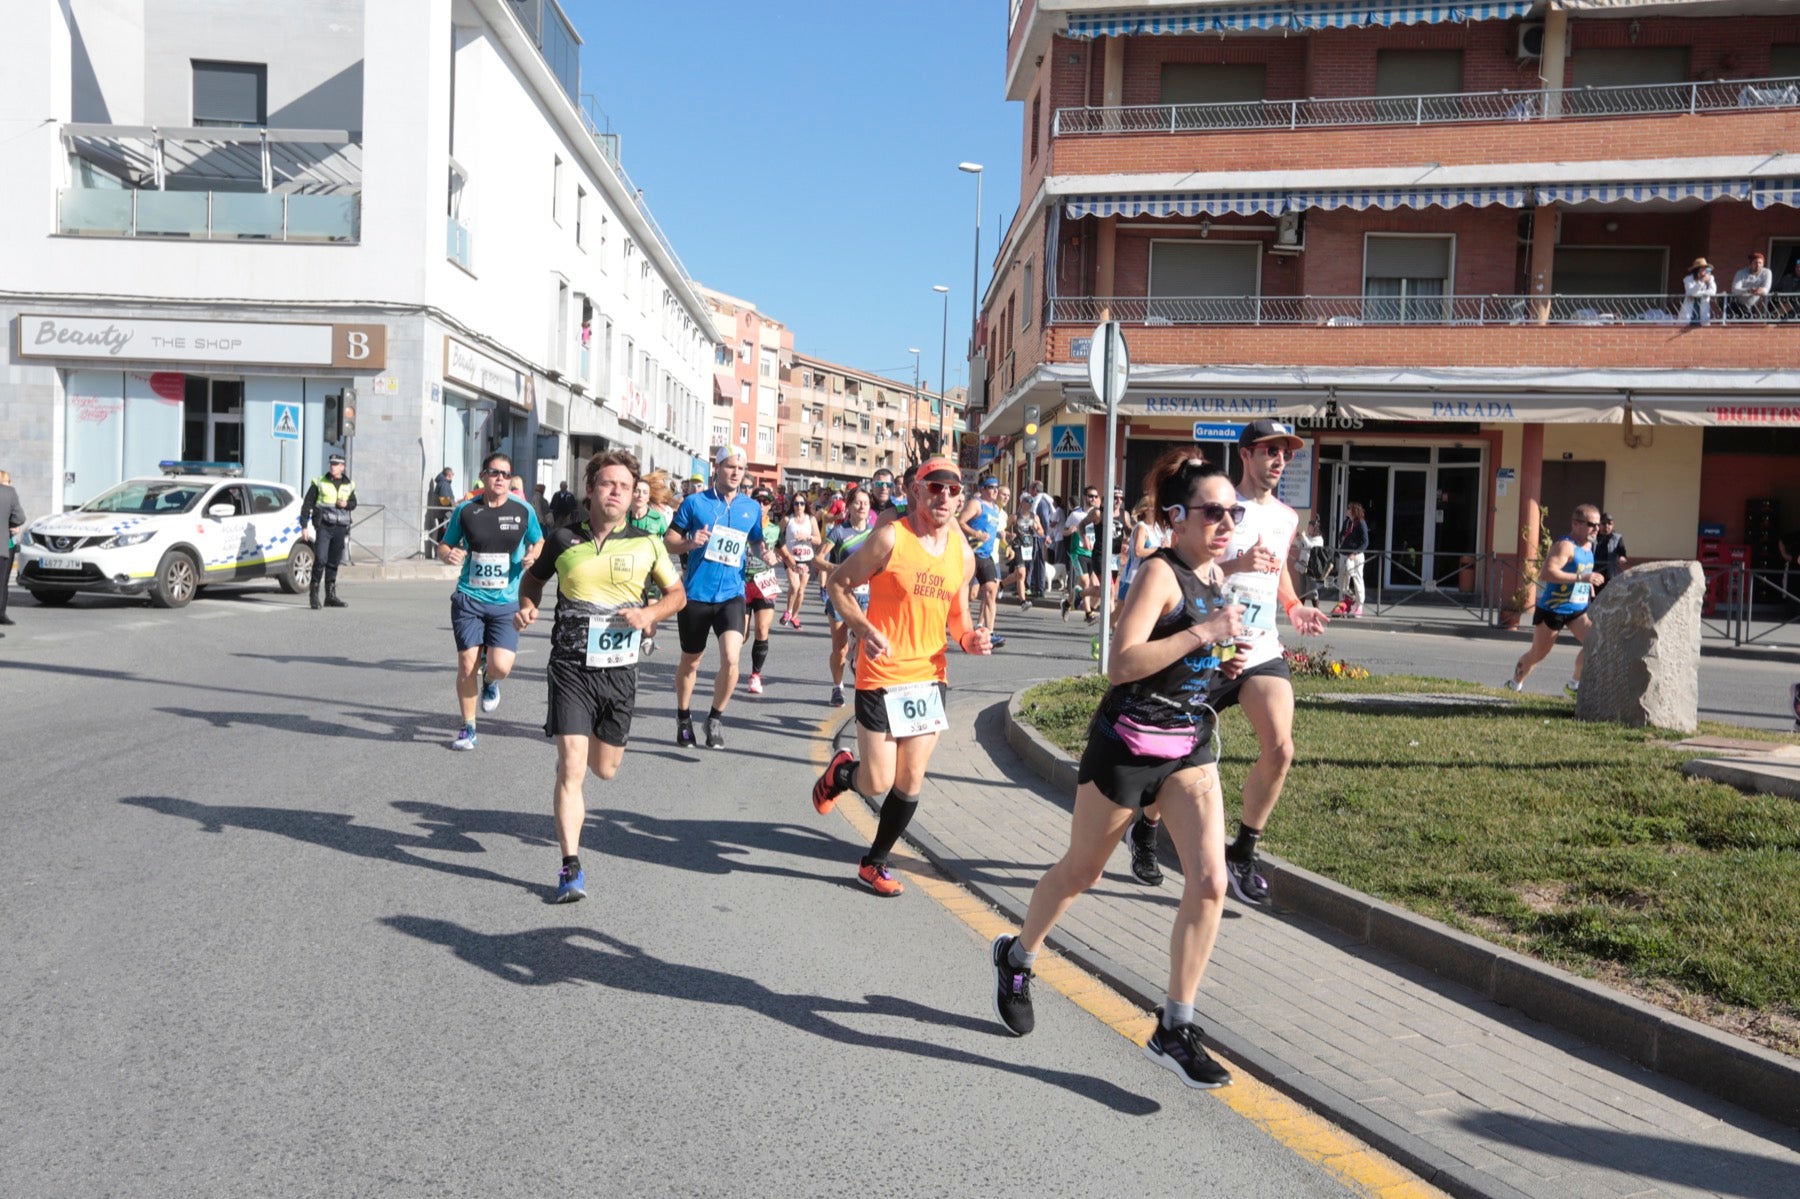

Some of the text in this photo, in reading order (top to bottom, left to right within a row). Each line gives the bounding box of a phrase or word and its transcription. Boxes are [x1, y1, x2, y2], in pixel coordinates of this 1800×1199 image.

[35, 321, 242, 355] Beauty THE SHOP
[347, 331, 370, 360] B
[1146, 397, 1278, 414] RESTAURANTE
[1431, 400, 1515, 418] PARADA
[1195, 427, 1236, 437] Granada
[717, 538, 740, 555] 180
[475, 564, 502, 577] 285
[916, 572, 945, 588] YO SOY
[914, 584, 936, 598] BEER
[598, 630, 633, 651] 621
[903, 699, 927, 719] 60
